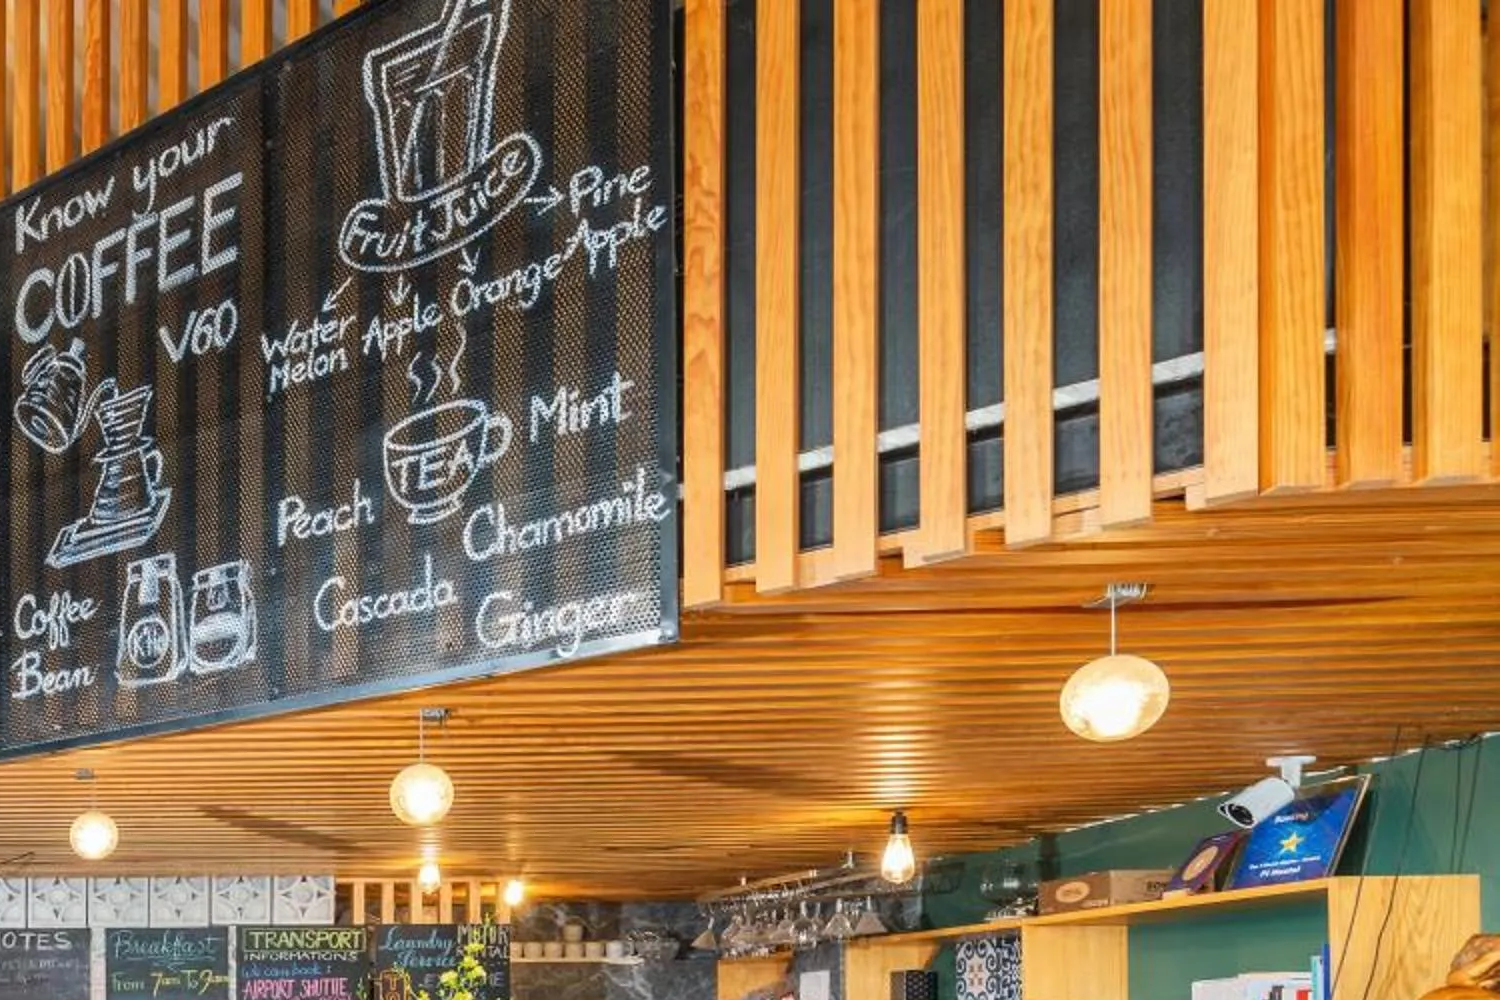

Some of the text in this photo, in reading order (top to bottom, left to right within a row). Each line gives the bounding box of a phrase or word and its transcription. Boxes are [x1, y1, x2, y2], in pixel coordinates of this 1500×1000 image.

[15, 115, 235, 254] Know your
[342, 148, 529, 260] Fruit Juice
[569, 163, 653, 218] Pine
[15, 171, 244, 345] COFFEE
[563, 196, 668, 280] Apple
[450, 251, 564, 319] Orange
[157, 297, 239, 364] V60
[261, 313, 358, 365] Water
[361, 293, 442, 362] Apple
[269, 346, 350, 395] Melon
[529, 370, 636, 443] Mint
[390, 441, 475, 494] TEA
[277, 479, 377, 549] Peach
[462, 467, 672, 562] Chamomile
[13, 590, 98, 650] Coffee
[475, 590, 641, 658] Ginger
[12, 650, 97, 702] Bean
[111, 929, 224, 959] Breakfast
[249, 931, 364, 949] TRANSPORT
